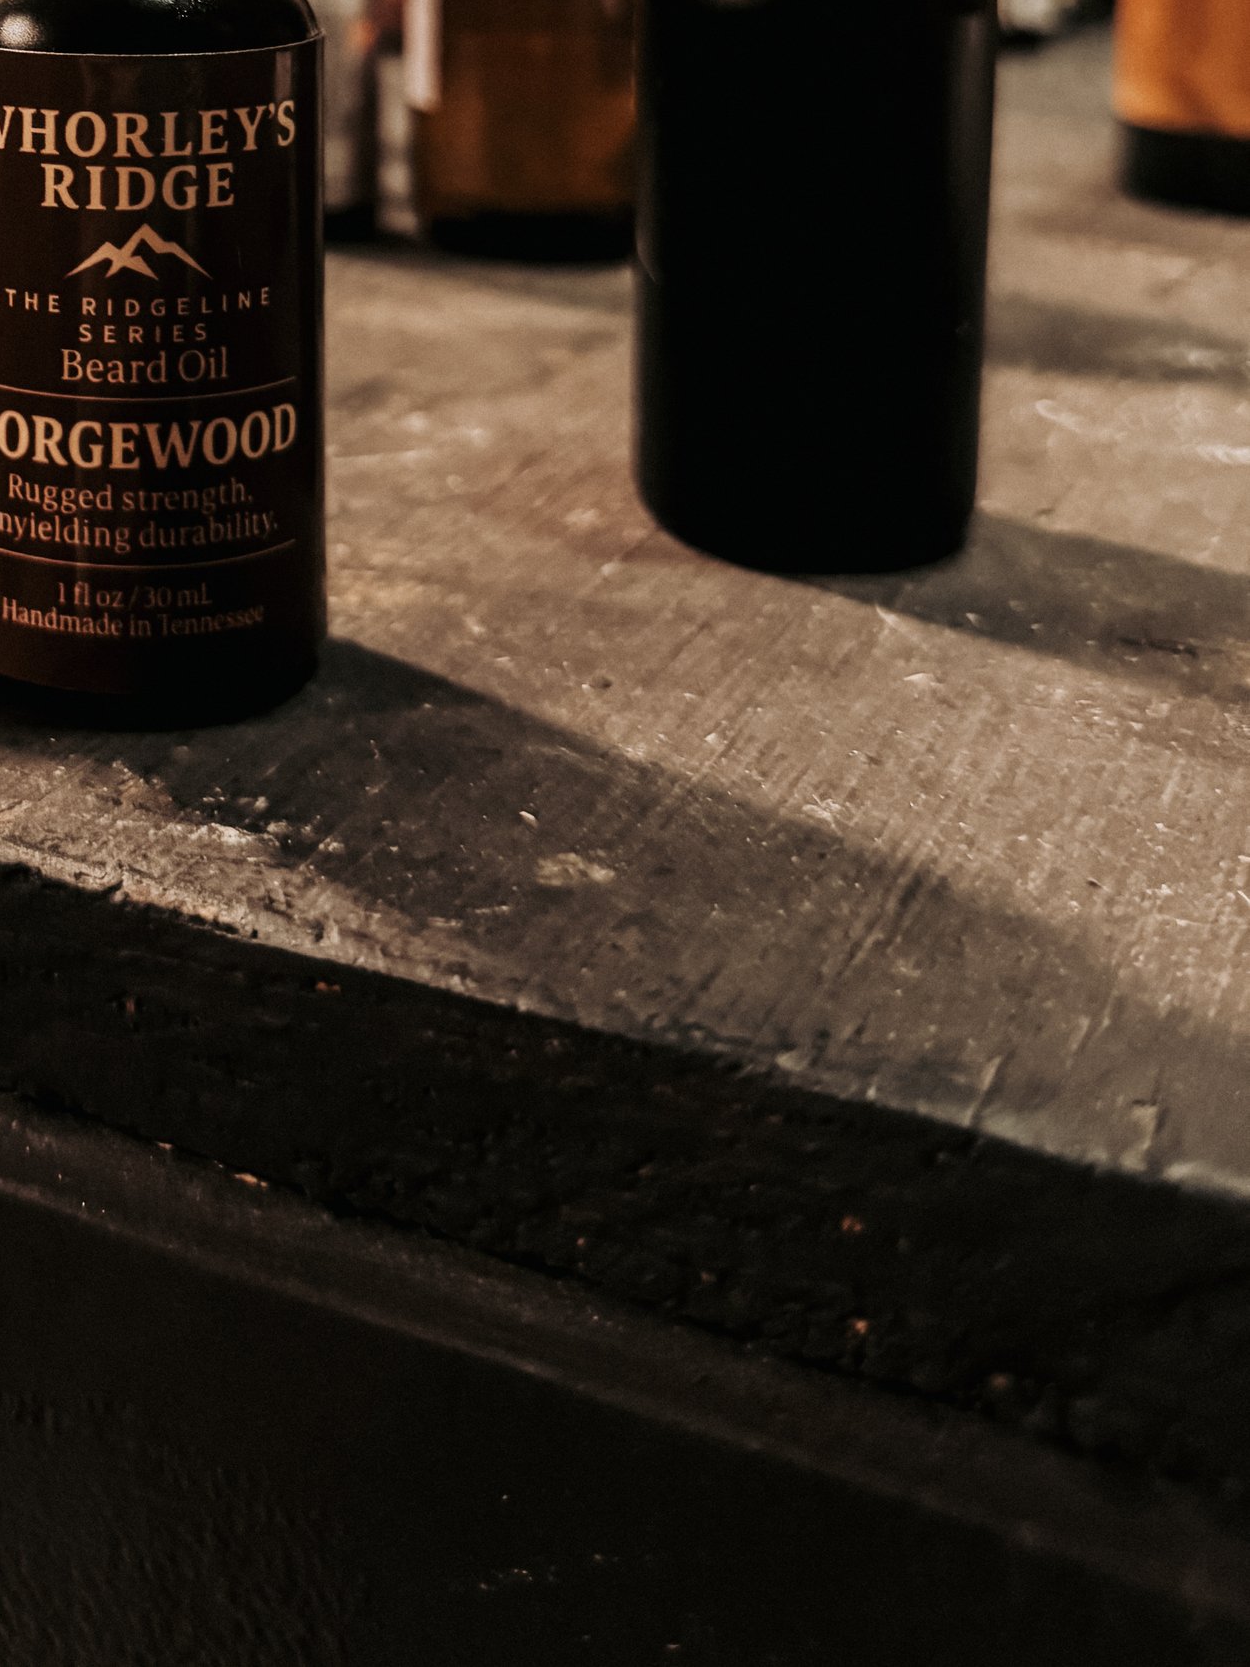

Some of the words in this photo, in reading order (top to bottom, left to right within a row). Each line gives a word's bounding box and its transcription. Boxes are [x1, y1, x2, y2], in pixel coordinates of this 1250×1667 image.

[40, 162, 236, 211] RIDGE
[5, 288, 61, 314] THE
[81, 286, 271, 317] RIDGELINE
[78, 323, 207, 344] SERIES
[60, 347, 168, 384] Beard
[177, 346, 229, 382] Oil
[7, 473, 113, 515] Rugged
[57, 582, 66, 604] 1
[73, 581, 91, 607] fl
[96, 587, 124, 609] oz
[143, 584, 173, 608] 30
[177, 581, 213, 607] mL
[1, 596, 123, 636] Handmade
[129, 612, 150, 636] in
[156, 604, 265, 636] Tennessee
